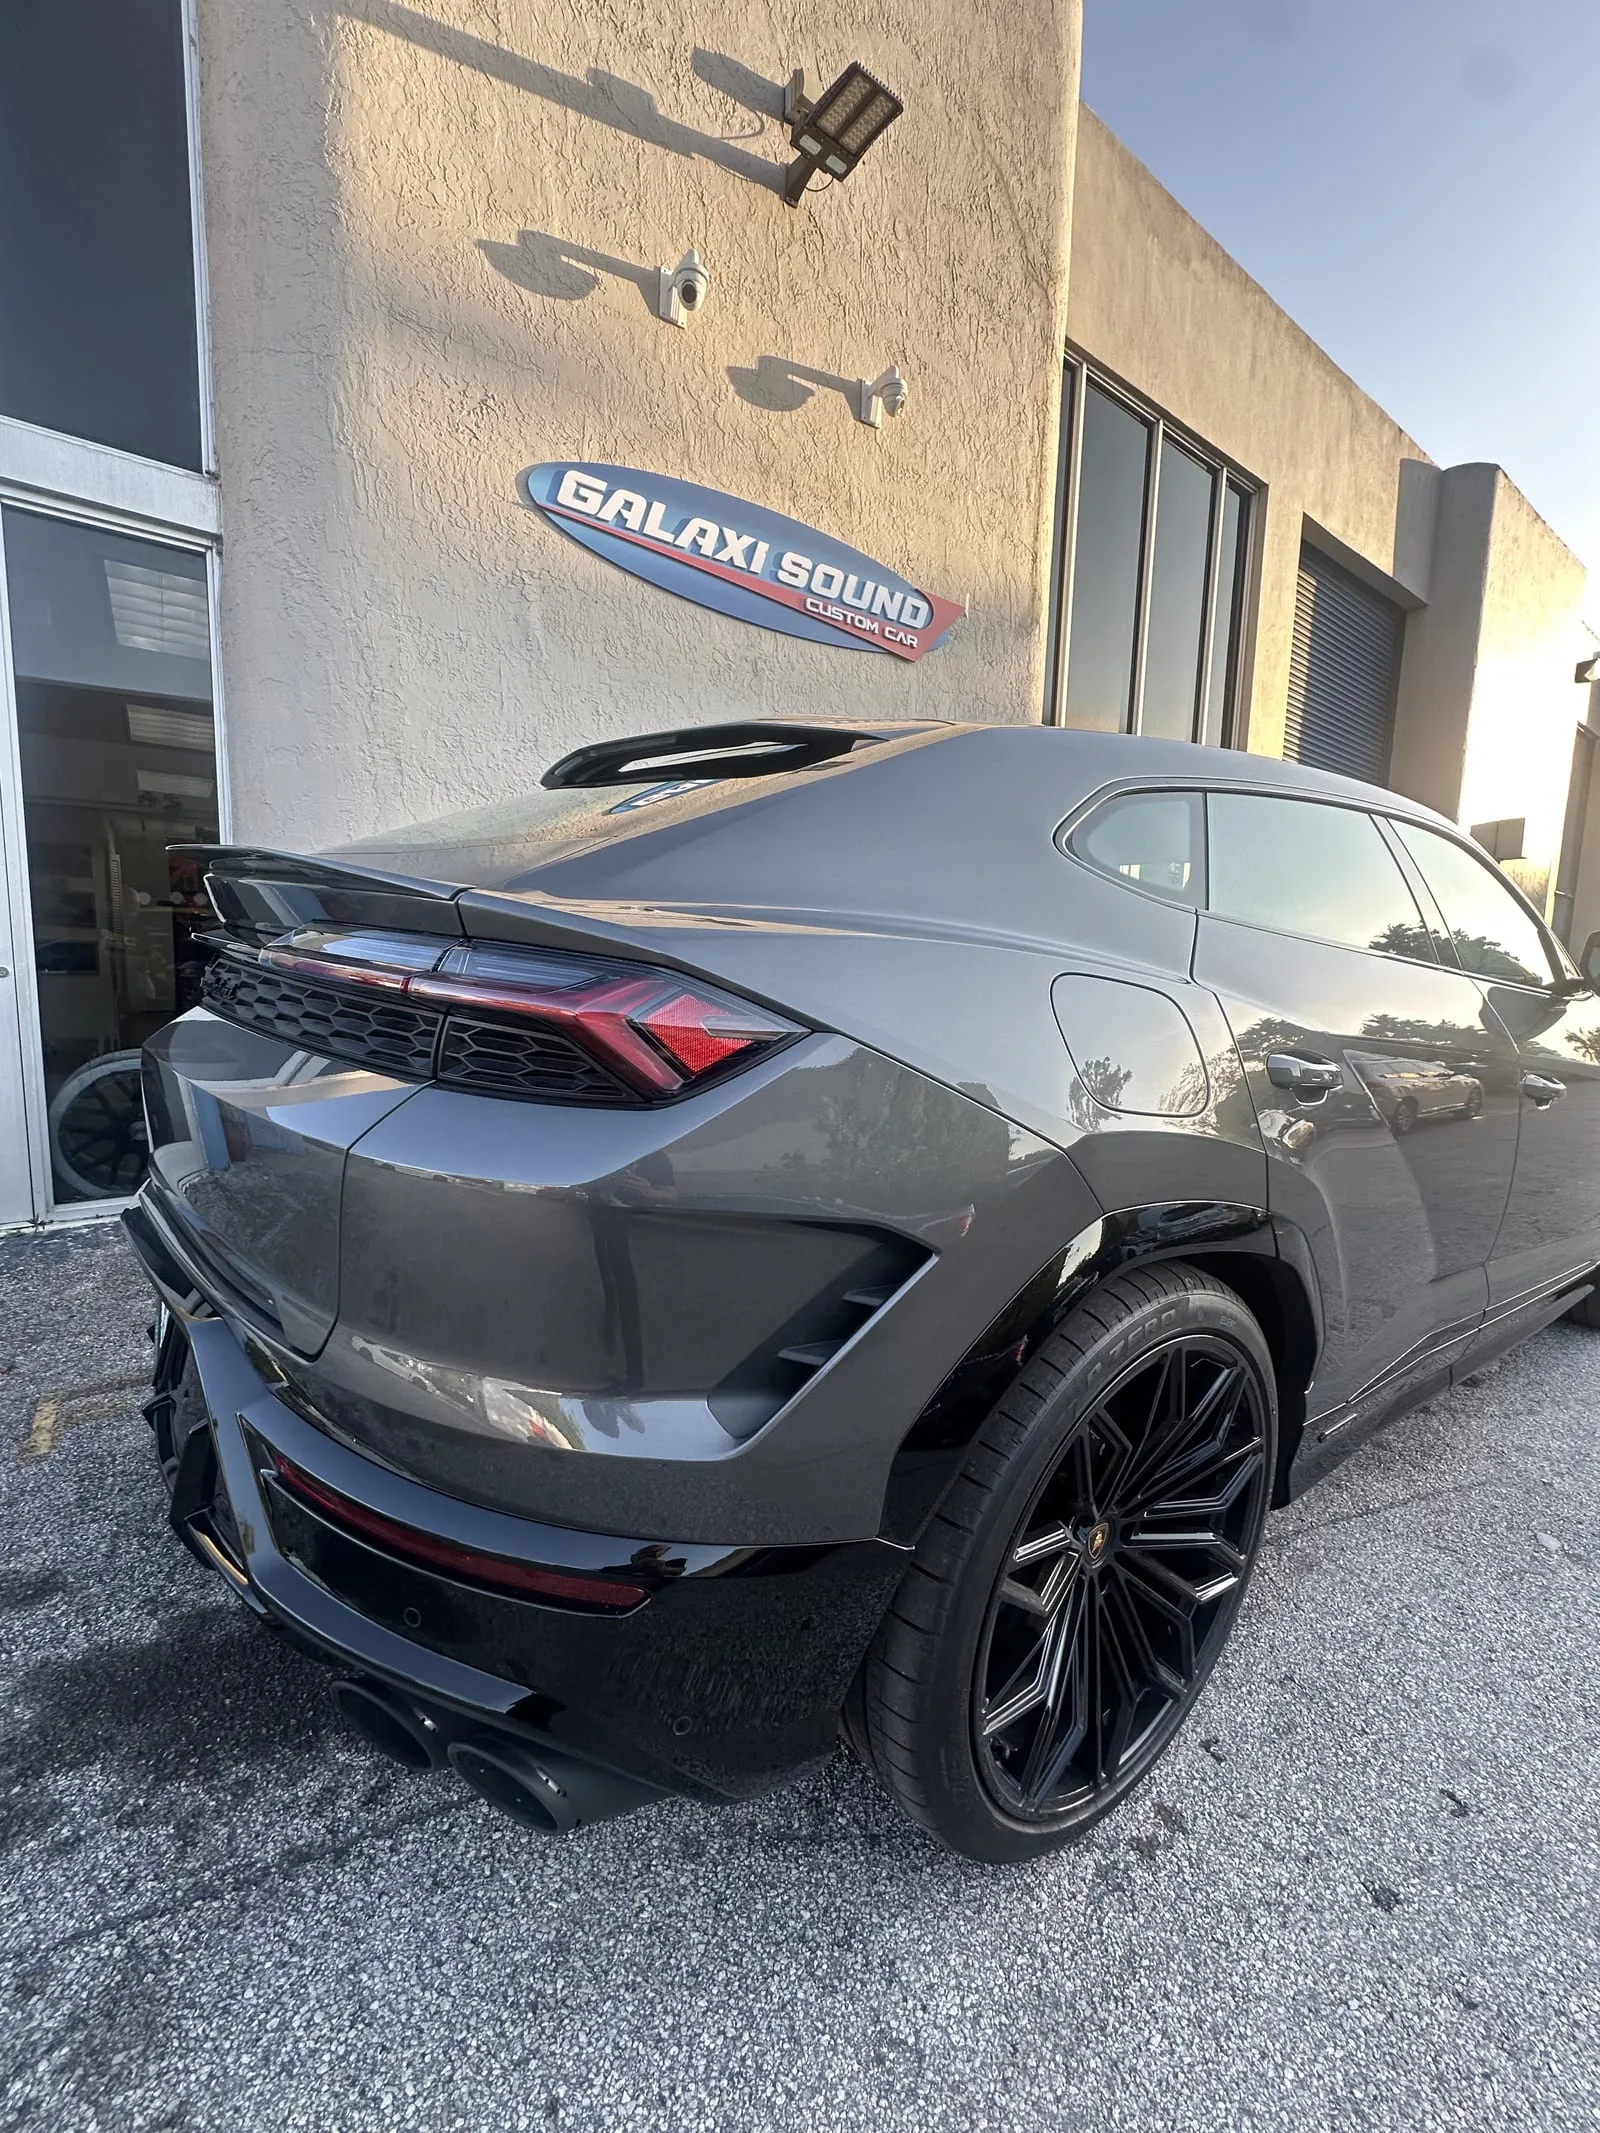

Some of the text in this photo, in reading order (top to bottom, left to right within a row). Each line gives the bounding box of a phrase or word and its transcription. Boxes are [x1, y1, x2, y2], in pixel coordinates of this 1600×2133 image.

[556, 470, 929, 629] GALAXI SOUND
[806, 598, 918, 649] CUSTOM CAR
